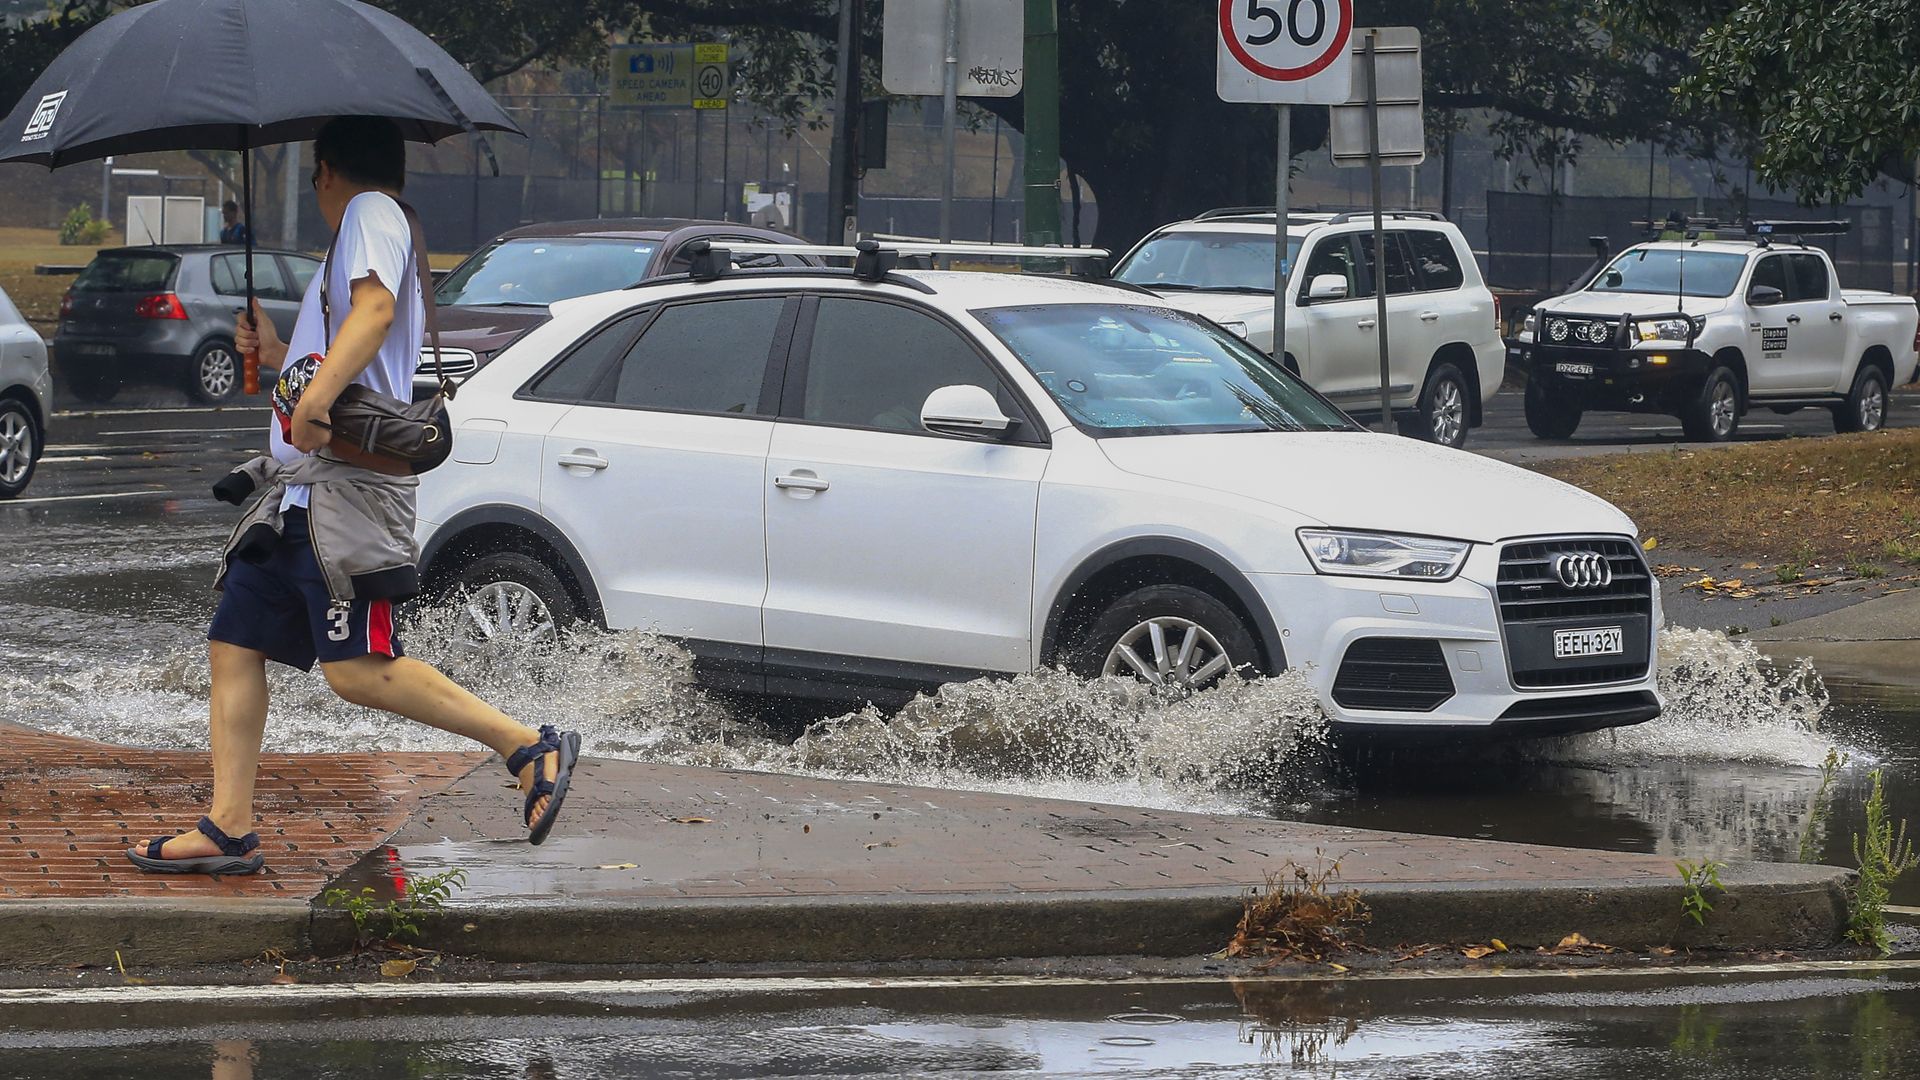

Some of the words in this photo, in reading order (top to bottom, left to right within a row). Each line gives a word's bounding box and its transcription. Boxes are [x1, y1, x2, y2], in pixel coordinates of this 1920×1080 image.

[1246, 0, 1326, 46] 50
[617, 79, 645, 89] SPEED
[649, 79, 687, 89] CAMERA
[702, 74, 720, 90] 40
[636, 92, 667, 101] AHEAD
[699, 100, 722, 108] AHEAD
[1763, 329, 1787, 338] Stephen
[1763, 340, 1786, 349] Edwards
[327, 607, 350, 641] 3
